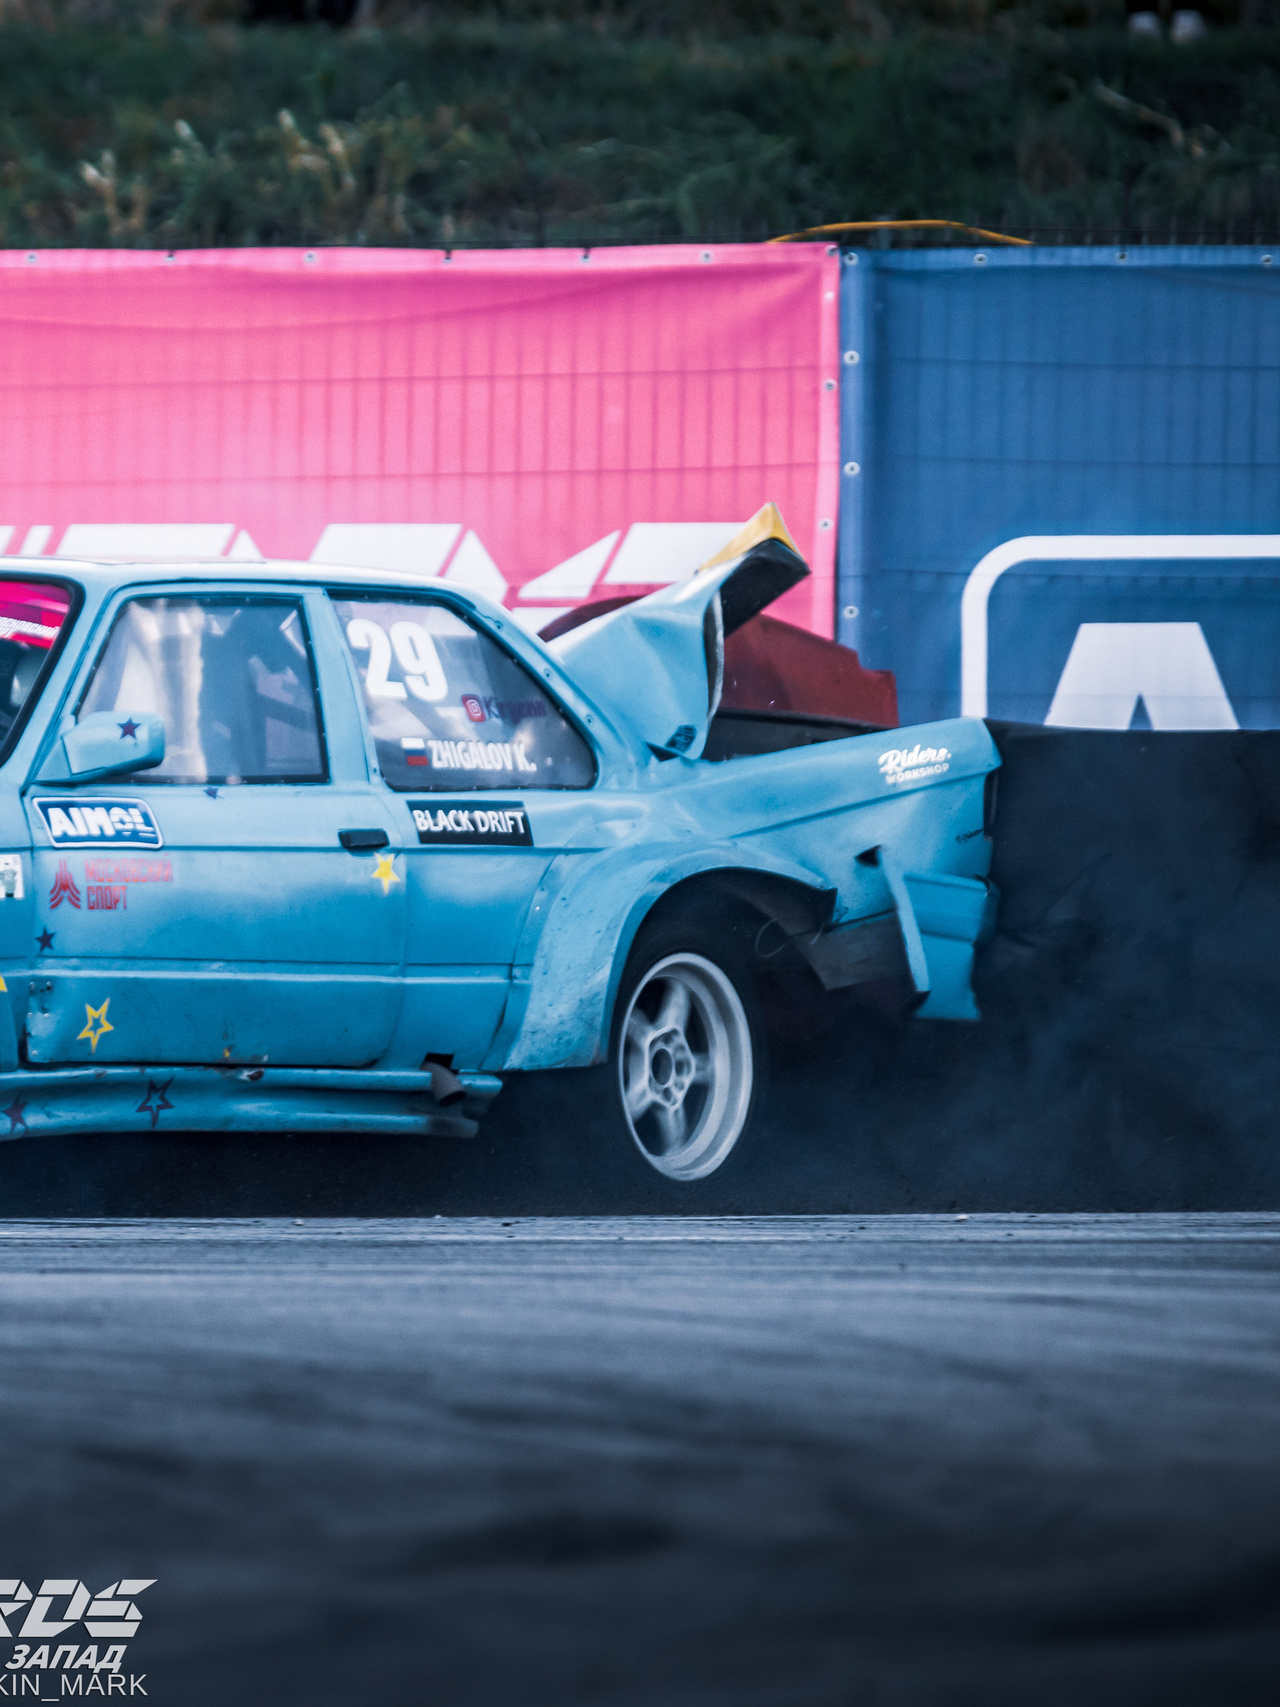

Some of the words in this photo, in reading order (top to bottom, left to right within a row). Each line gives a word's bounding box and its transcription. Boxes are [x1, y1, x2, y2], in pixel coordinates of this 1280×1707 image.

[346, 619, 448, 700] 29
[427, 739, 512, 770] ZHIGALOV
[514, 742, 537, 772] K.
[885, 763, 949, 785] WORKSHOP
[47, 806, 156, 837] AIMOL
[412, 809, 474, 832] BLACK
[473, 811, 525, 834] DRIFT
[86, 885, 127, 910] СПОРТ
